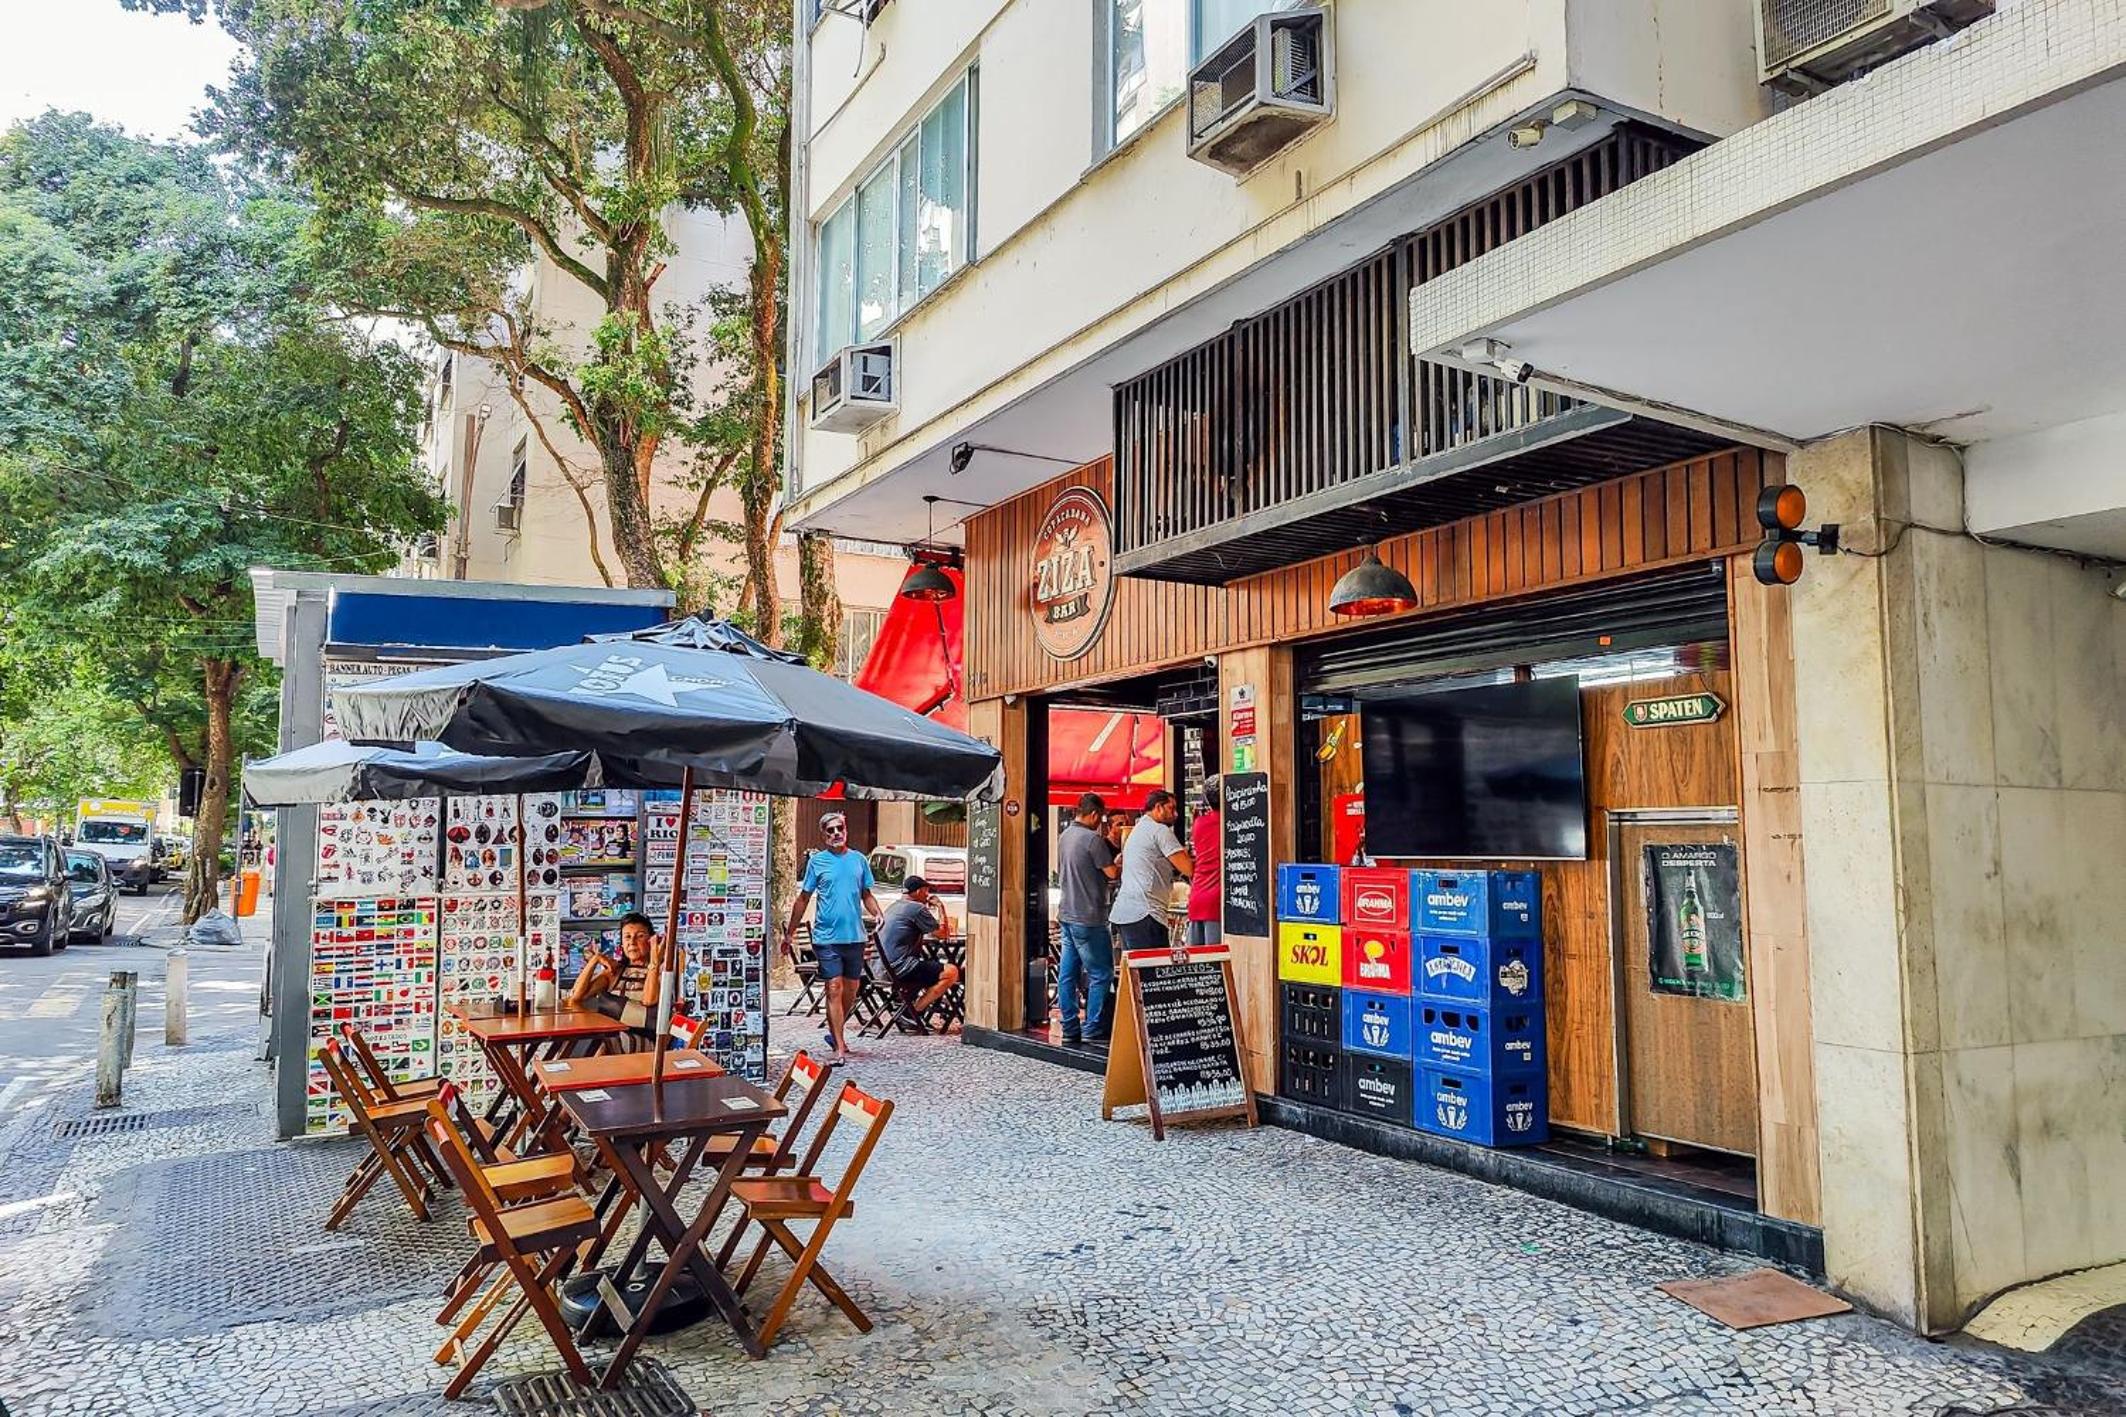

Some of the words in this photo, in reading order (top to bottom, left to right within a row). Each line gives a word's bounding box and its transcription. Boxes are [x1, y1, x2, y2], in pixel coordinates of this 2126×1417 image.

[1043, 508, 1091, 540] COPACABANA
[1037, 545, 1097, 602] ZIZA
[1053, 600, 1077, 619] BAR
[1649, 698, 1703, 720] SPATEN
[1672, 852, 1717, 860] AMARGO
[1296, 883, 1320, 894] ambev
[1358, 897, 1393, 909] BRAHMA
[1427, 892, 1468, 907] ambev
[1502, 900, 1528, 910] ambev
[1291, 944, 1329, 967] SKOL
[1360, 962, 1391, 979] BRAHMA
[1362, 1013, 1390, 1026] ambev
[1431, 1031, 1472, 1049] ambev
[1504, 1040, 1531, 1051] ambev
[1358, 1078, 1395, 1096] ambev
[1436, 1092, 1467, 1107] ambev
[1506, 1101, 1533, 1112] ambev
